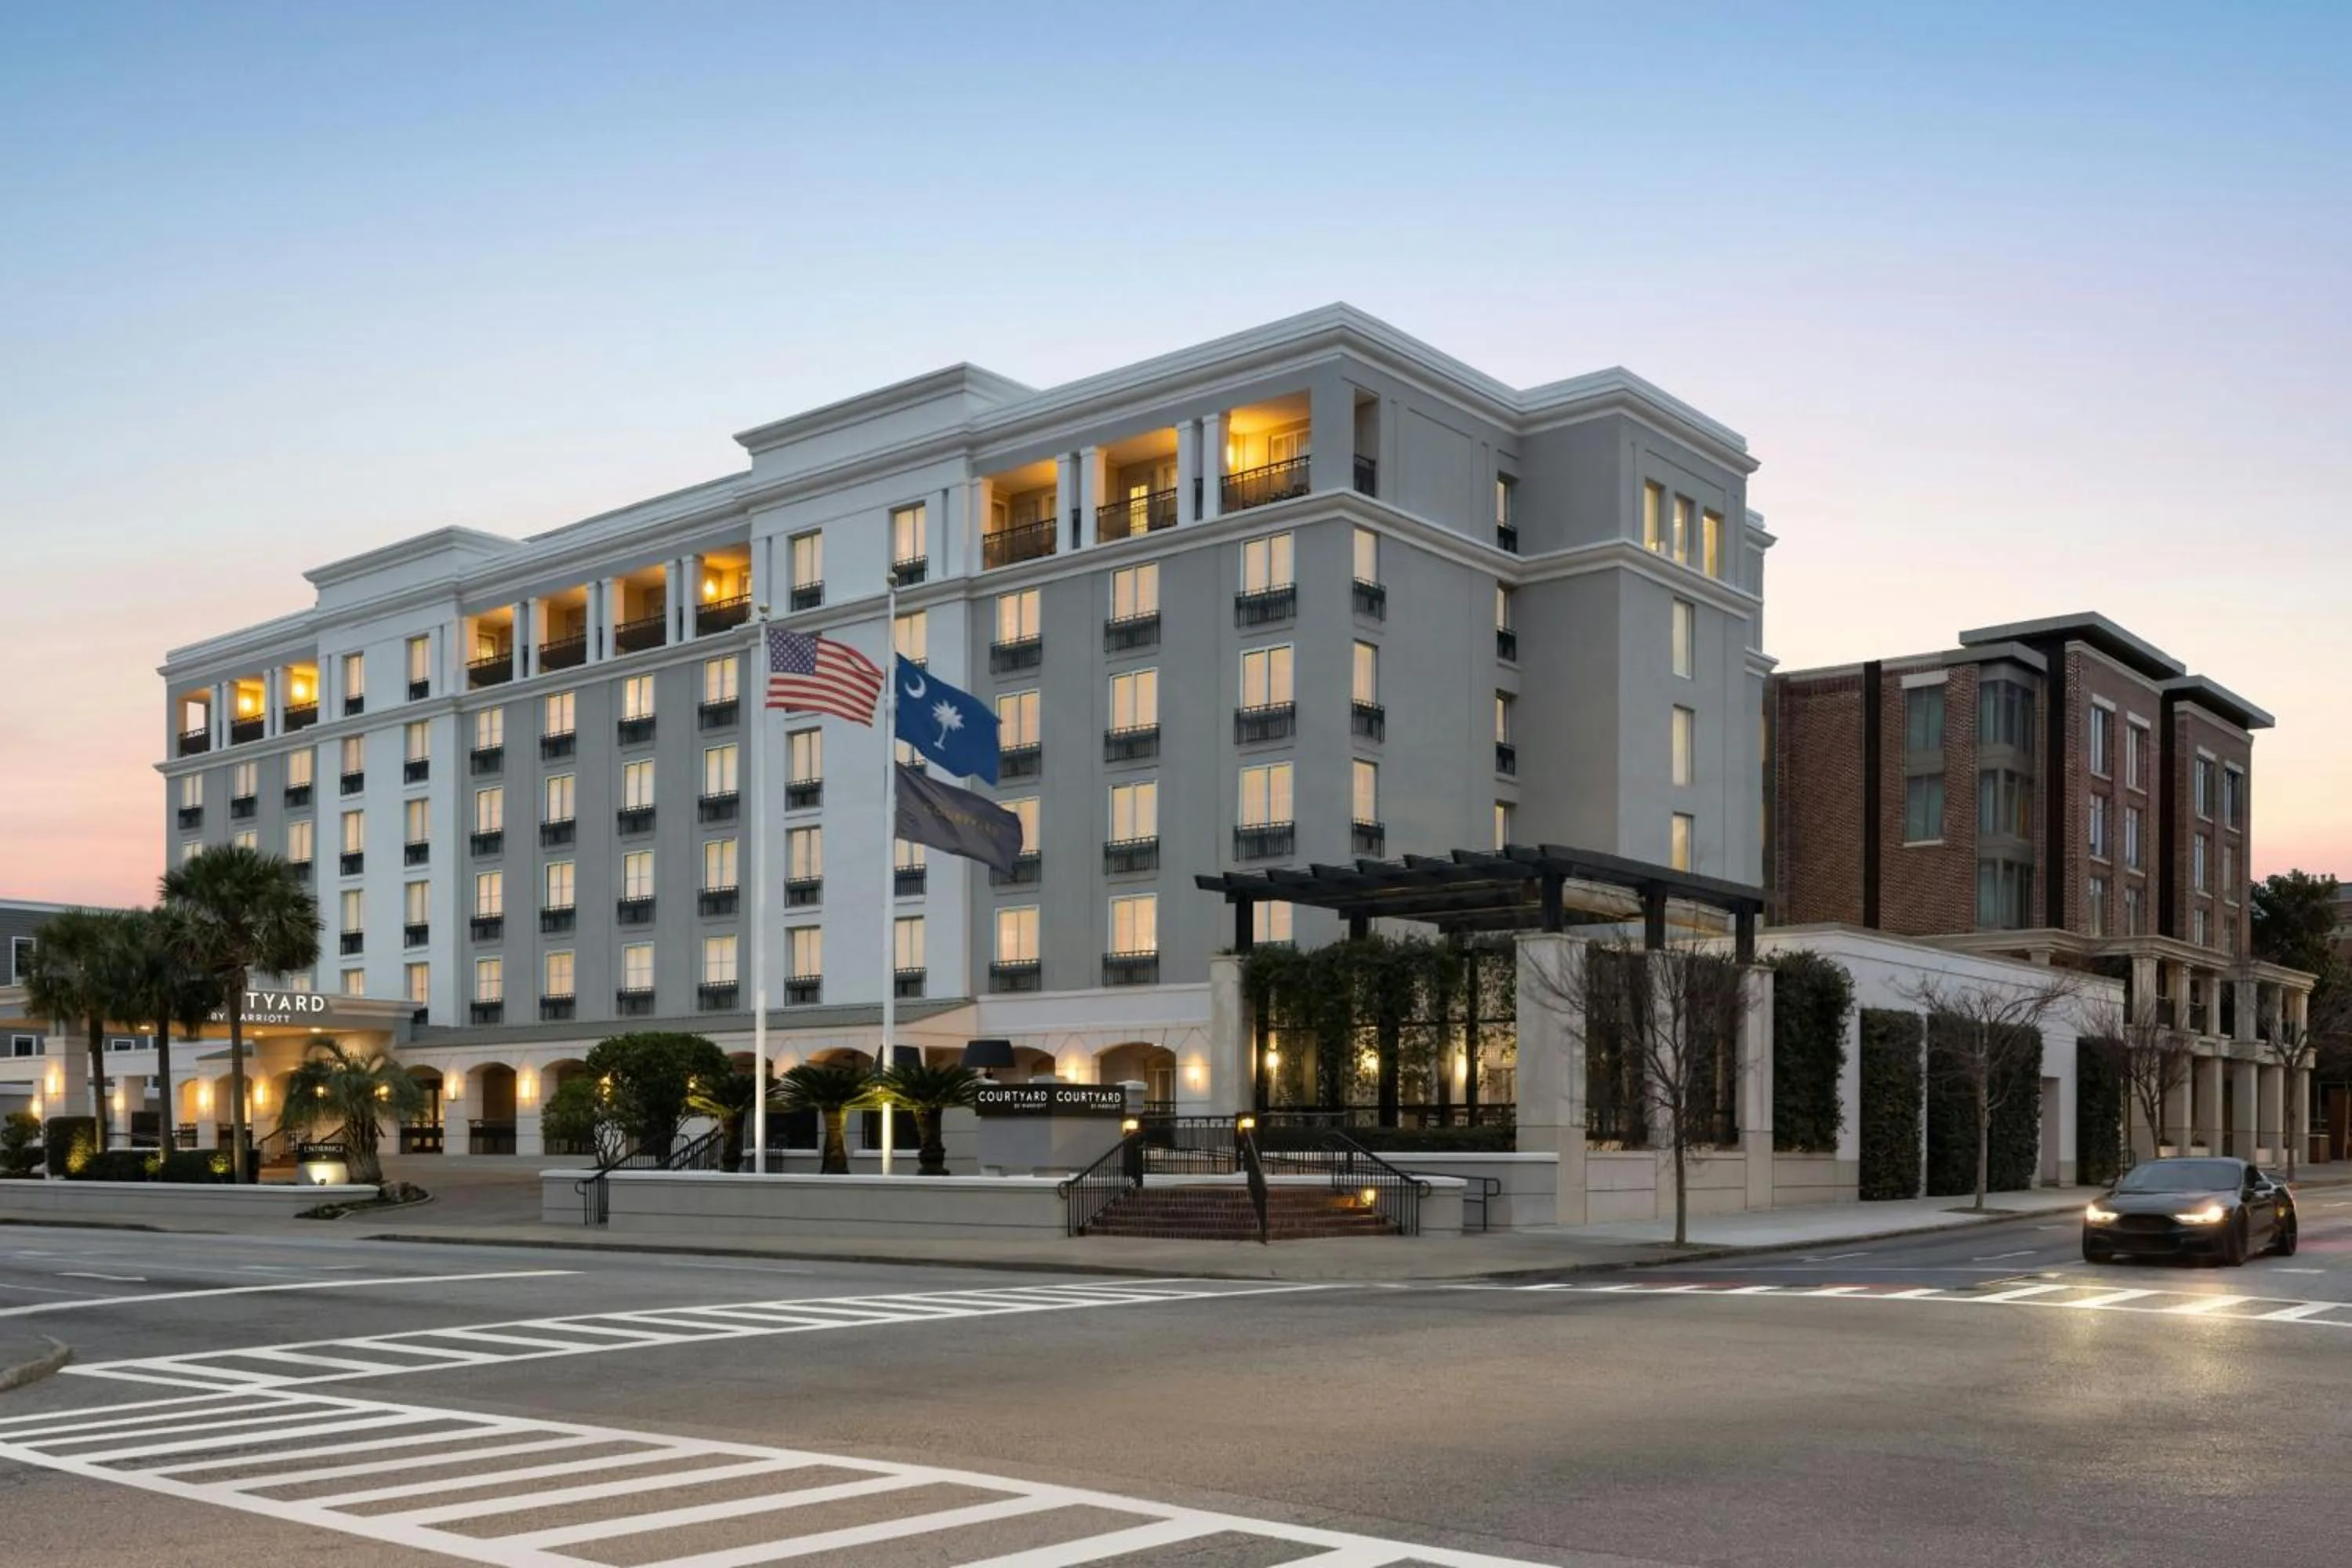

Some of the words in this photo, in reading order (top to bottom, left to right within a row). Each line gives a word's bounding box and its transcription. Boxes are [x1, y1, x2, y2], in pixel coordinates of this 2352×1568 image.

[245, 992, 325, 1012] TYARD
[239, 1012, 291, 1023] ARRIOTT
[978, 1091, 1048, 1102] COURTYARD
[1056, 1091, 1121, 1103] COURTYARD
